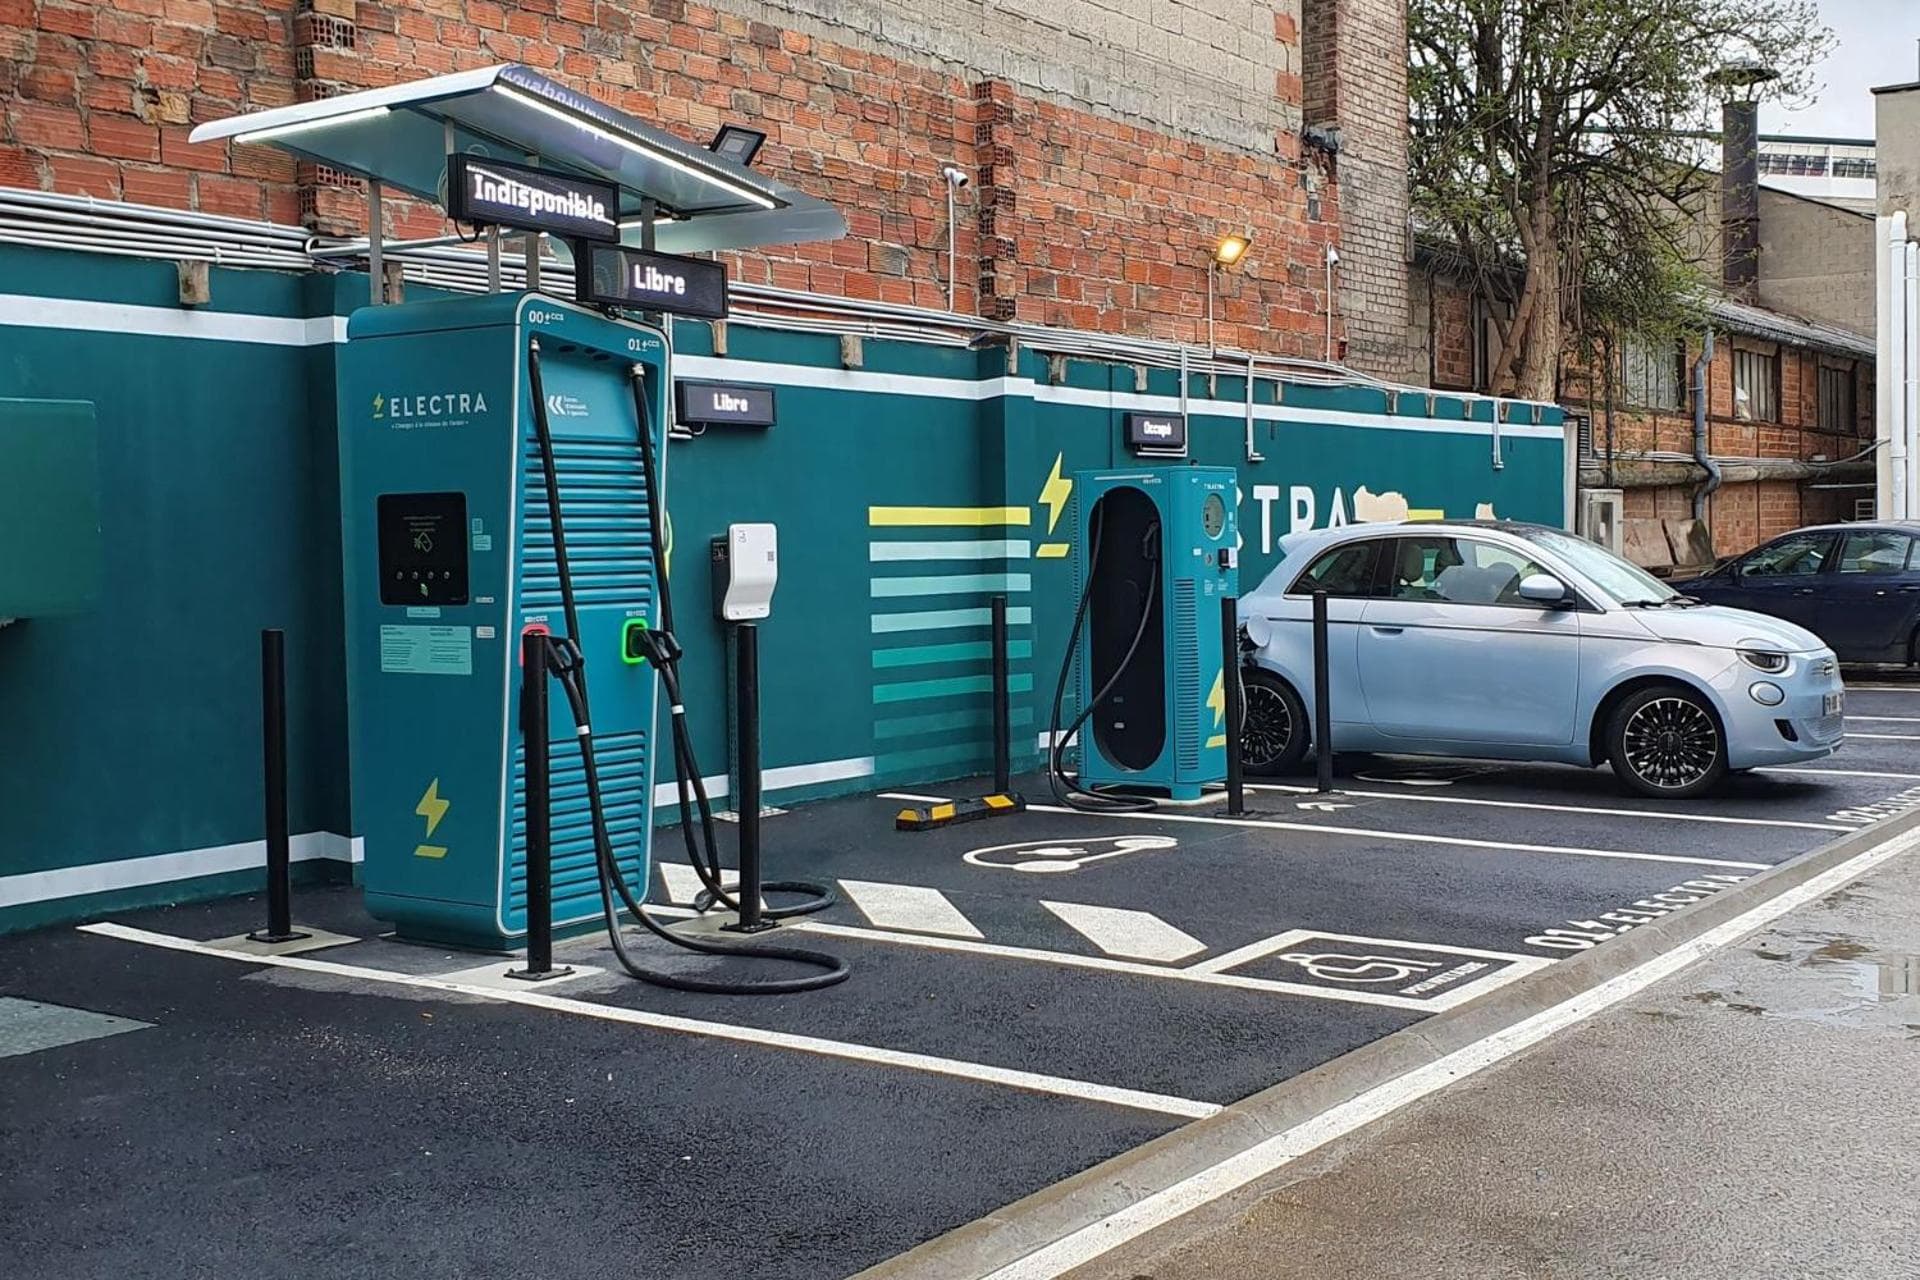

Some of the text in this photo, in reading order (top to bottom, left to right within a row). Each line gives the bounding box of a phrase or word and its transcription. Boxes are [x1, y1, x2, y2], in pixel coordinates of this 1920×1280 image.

[473, 173, 605, 220] Indisponible
[634, 264, 686, 294] Libre
[627, 338, 642, 351] 01
[390, 392, 488, 418] ELECTRA
[713, 393, 749, 412] Libre
[1524, 874, 1750, 949] 01 ELECTRA
